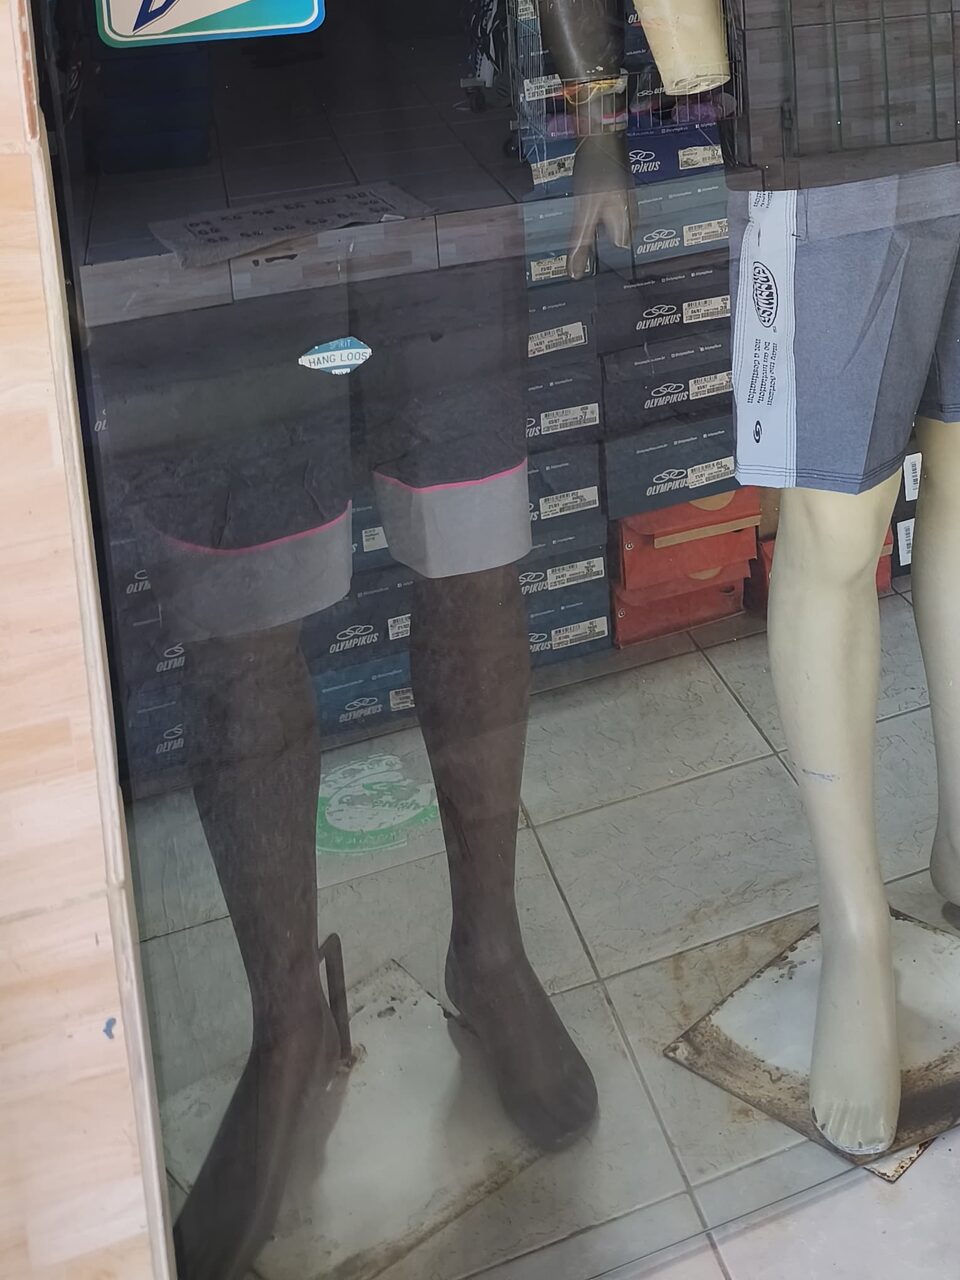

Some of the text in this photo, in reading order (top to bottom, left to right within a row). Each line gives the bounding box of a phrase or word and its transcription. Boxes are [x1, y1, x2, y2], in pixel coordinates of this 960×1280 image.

[637, 237, 681, 255] OLYMPIKUS
[636, 313, 682, 331] OLYMPIKUS
[308, 353, 336, 368] HANG
[747, 360, 760, 404] destination
[644, 391, 689, 409] OLYMPIKUS
[329, 632, 379, 654] OLYMPIKUS
